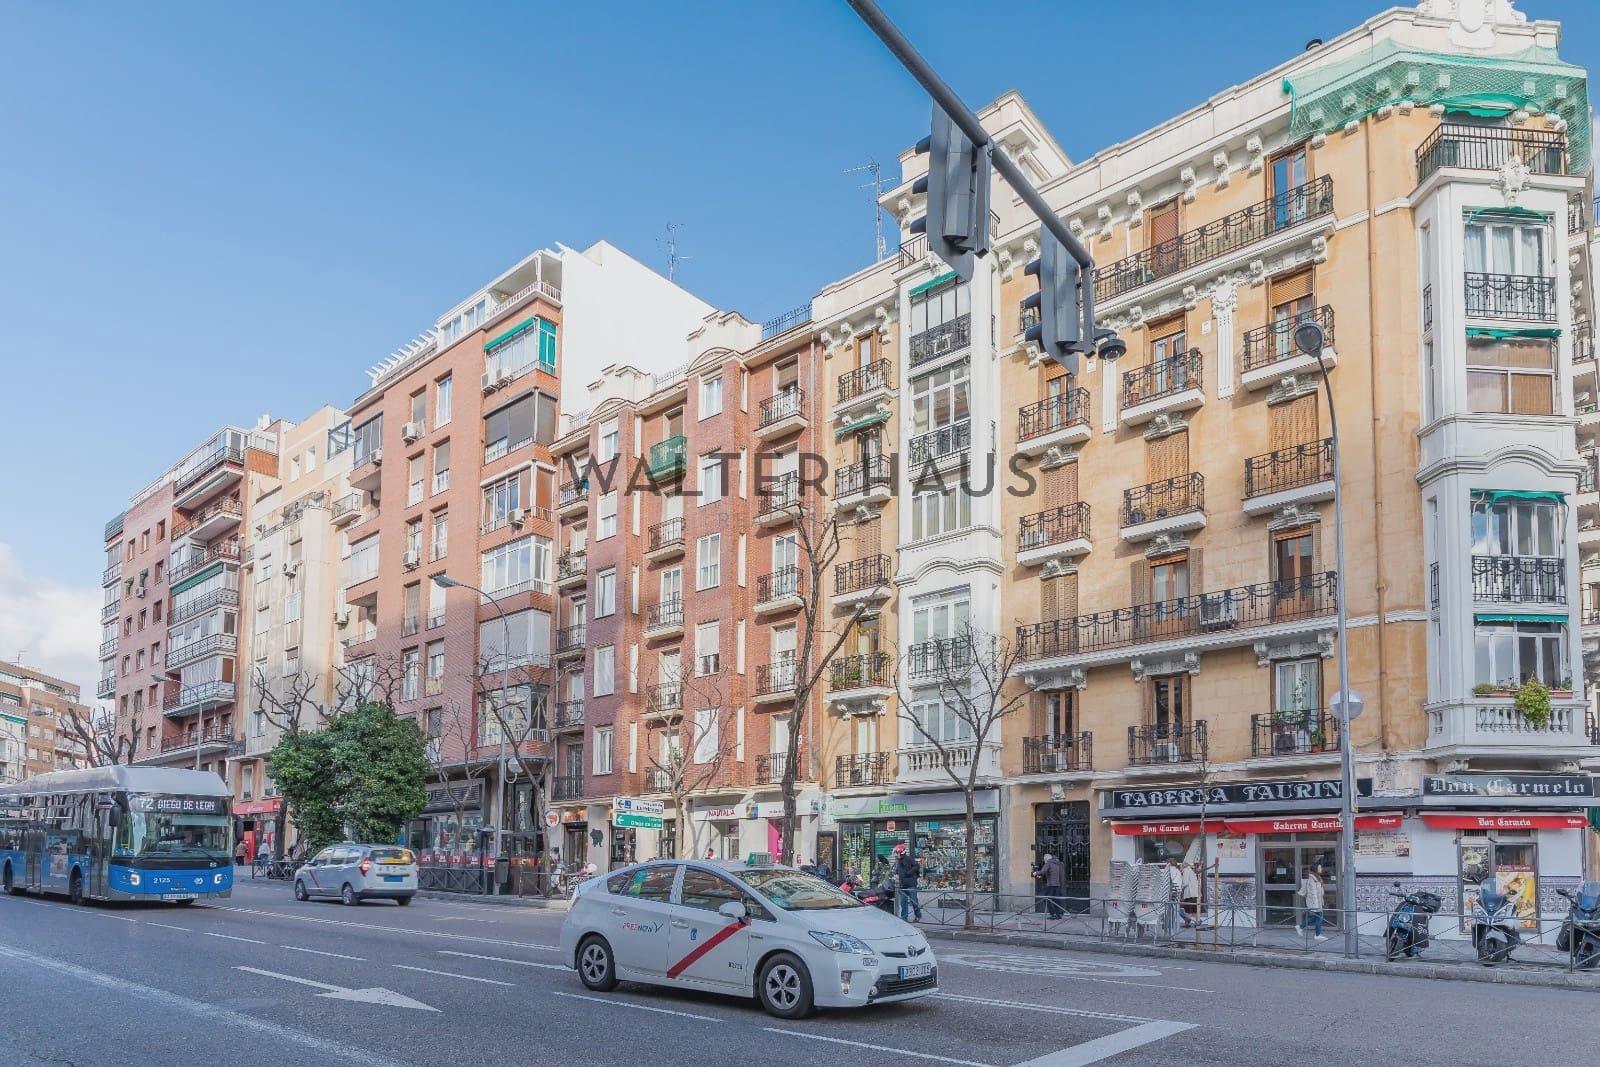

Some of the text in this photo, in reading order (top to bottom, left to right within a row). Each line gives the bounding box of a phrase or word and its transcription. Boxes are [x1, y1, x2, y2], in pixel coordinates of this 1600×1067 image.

[1430, 778, 1584, 794] Don Carmelo
[1120, 782, 1362, 807] TABERNA TAURIN
[140, 799, 154, 810] 72
[158, 800, 181, 810] DIEGO
[184, 801, 193, 809] DE
[1311, 820, 1344, 829] Taurin
